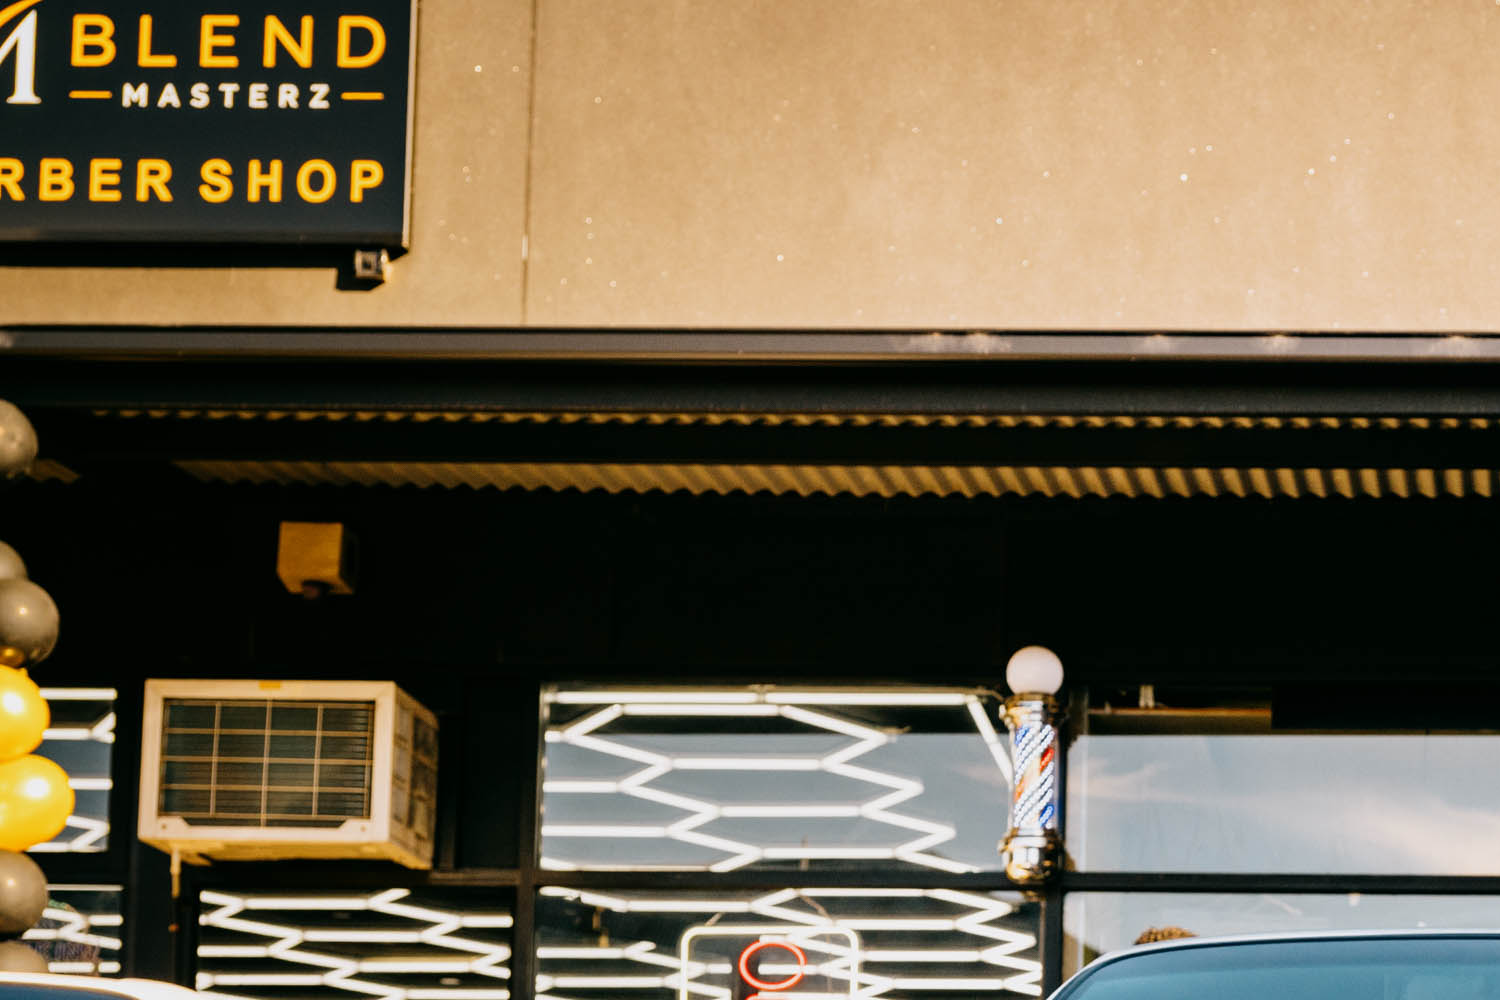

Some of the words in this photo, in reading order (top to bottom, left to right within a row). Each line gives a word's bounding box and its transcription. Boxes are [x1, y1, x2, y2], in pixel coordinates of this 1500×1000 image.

[71, 13, 387, 69] BLEND
[121, 81, 331, 109] MASTERZ
[199, 157, 385, 204] SHOP
